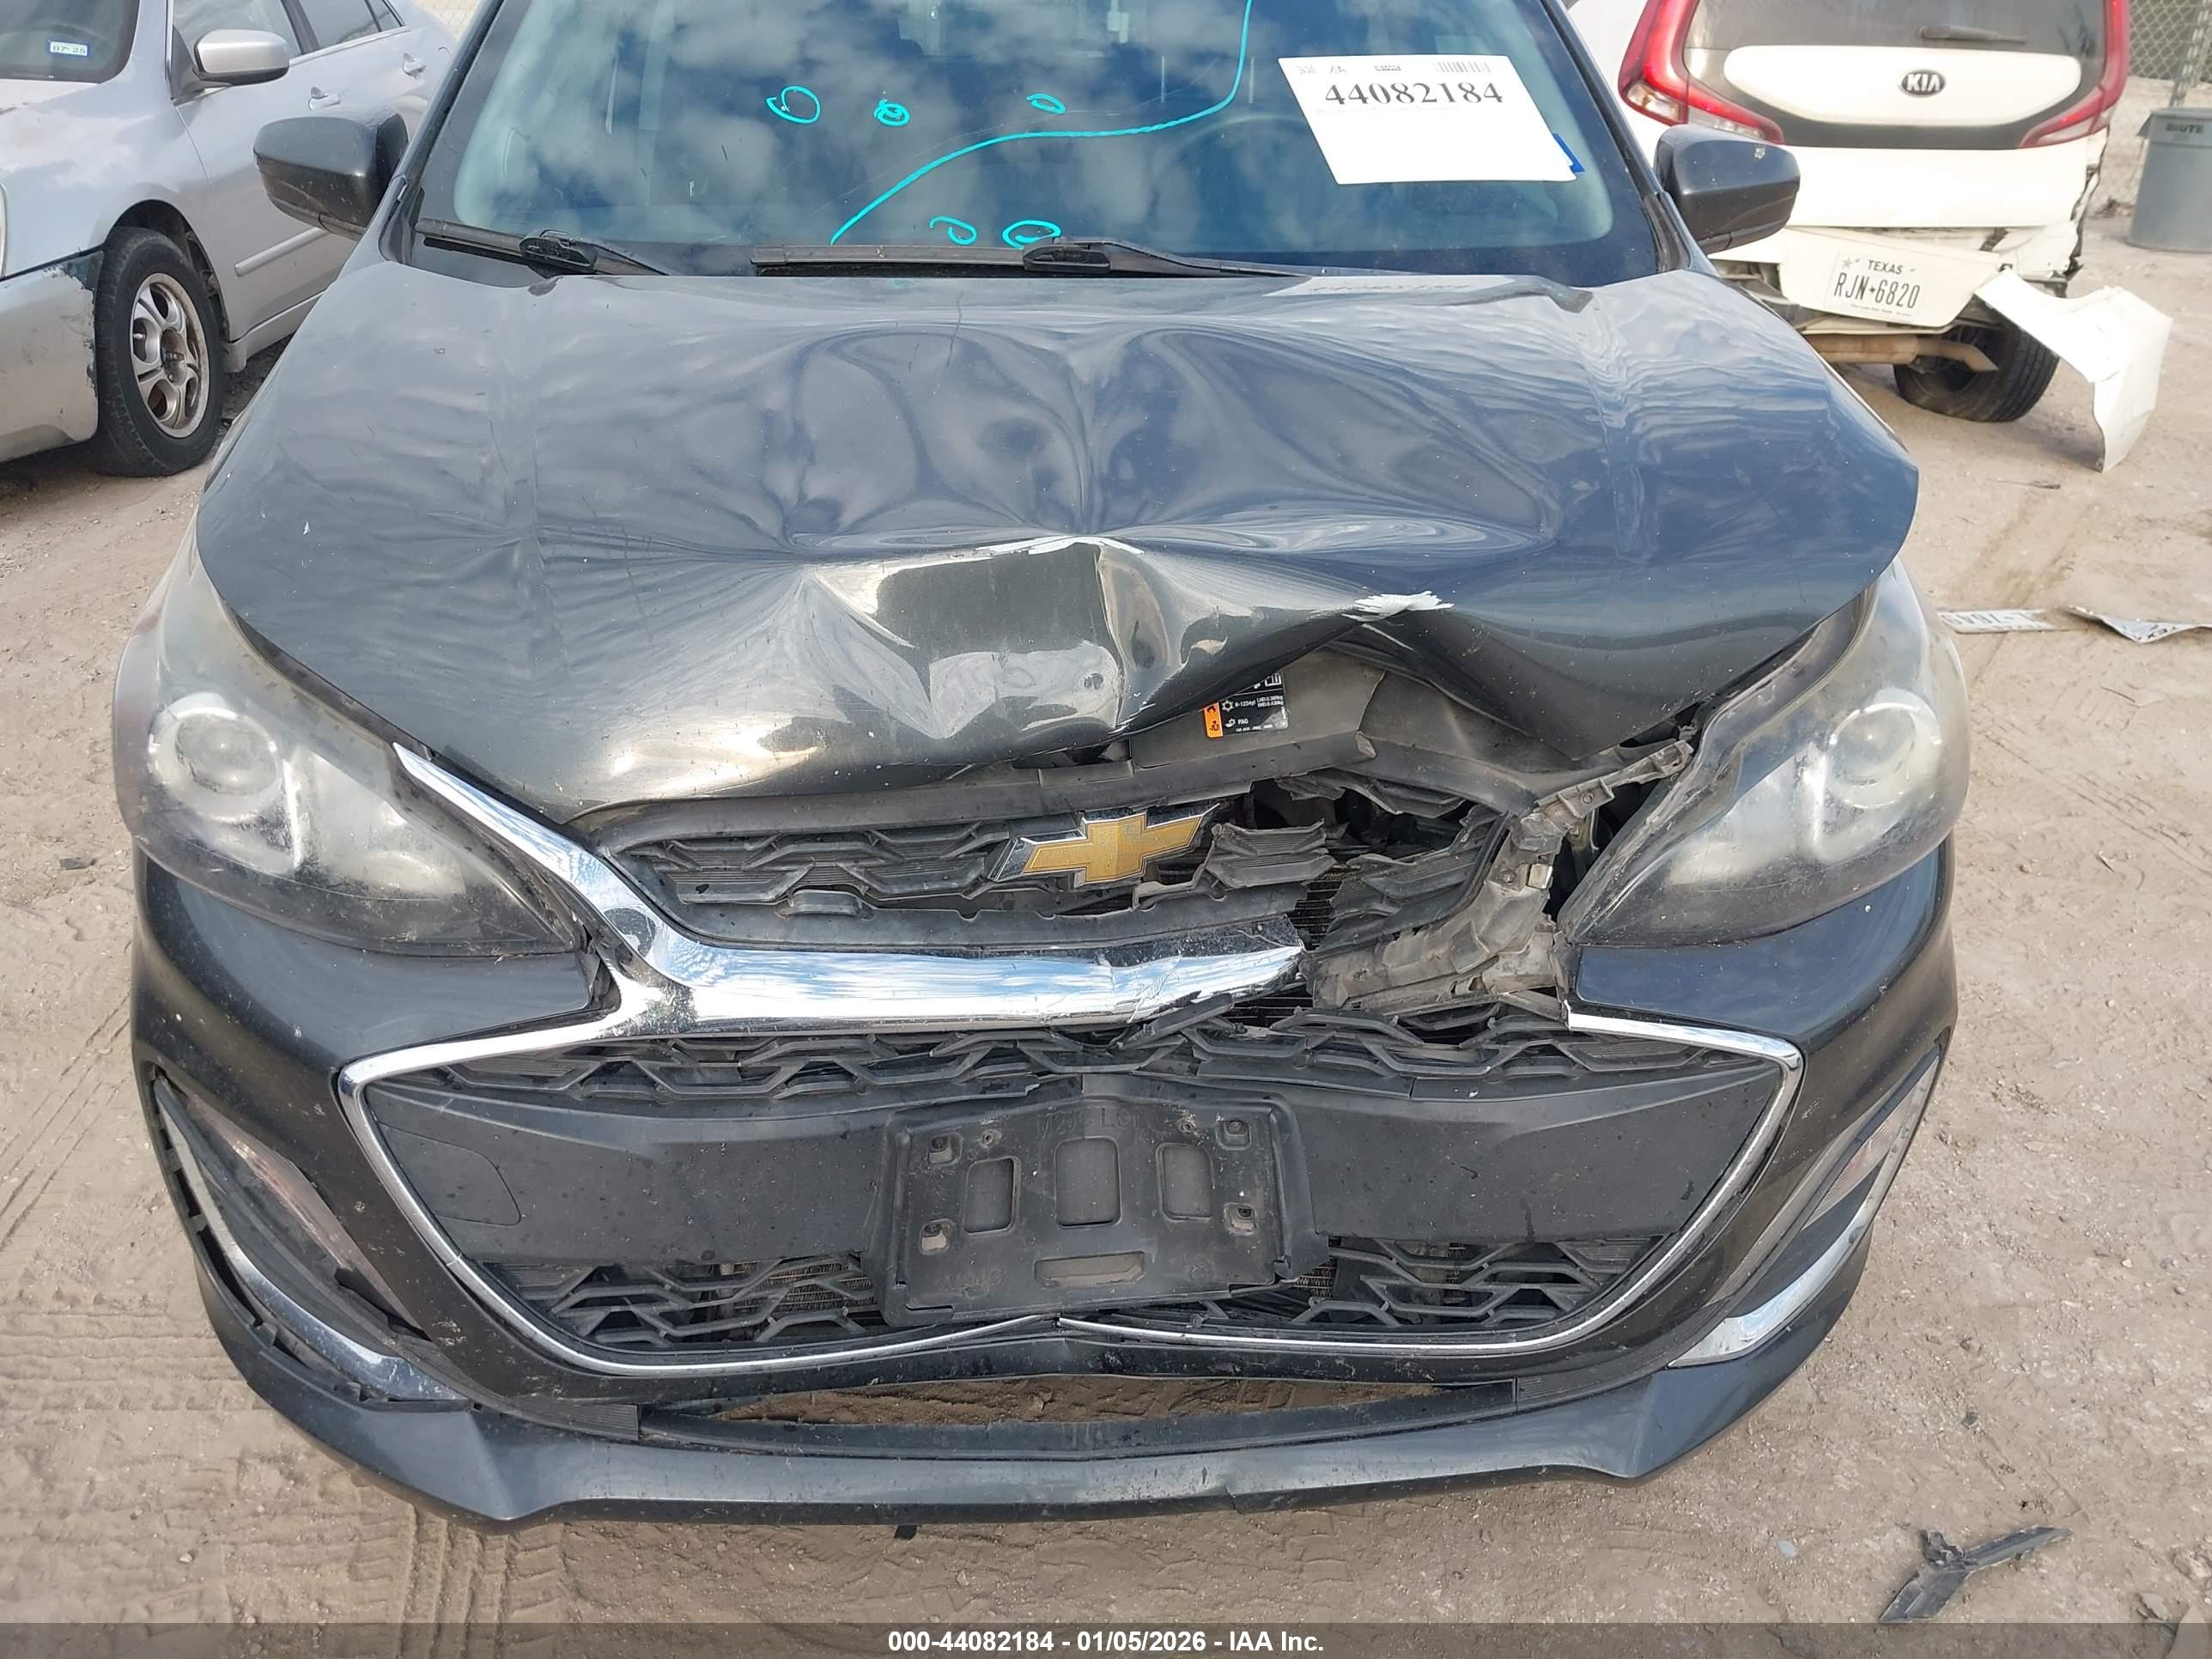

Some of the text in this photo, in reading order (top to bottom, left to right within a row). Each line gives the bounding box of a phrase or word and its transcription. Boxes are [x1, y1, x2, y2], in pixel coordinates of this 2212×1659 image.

[1906, 74, 1941, 91] KIA
[1325, 82, 1503, 105] 44082184
[1868, 259, 1904, 275] TEXAS
